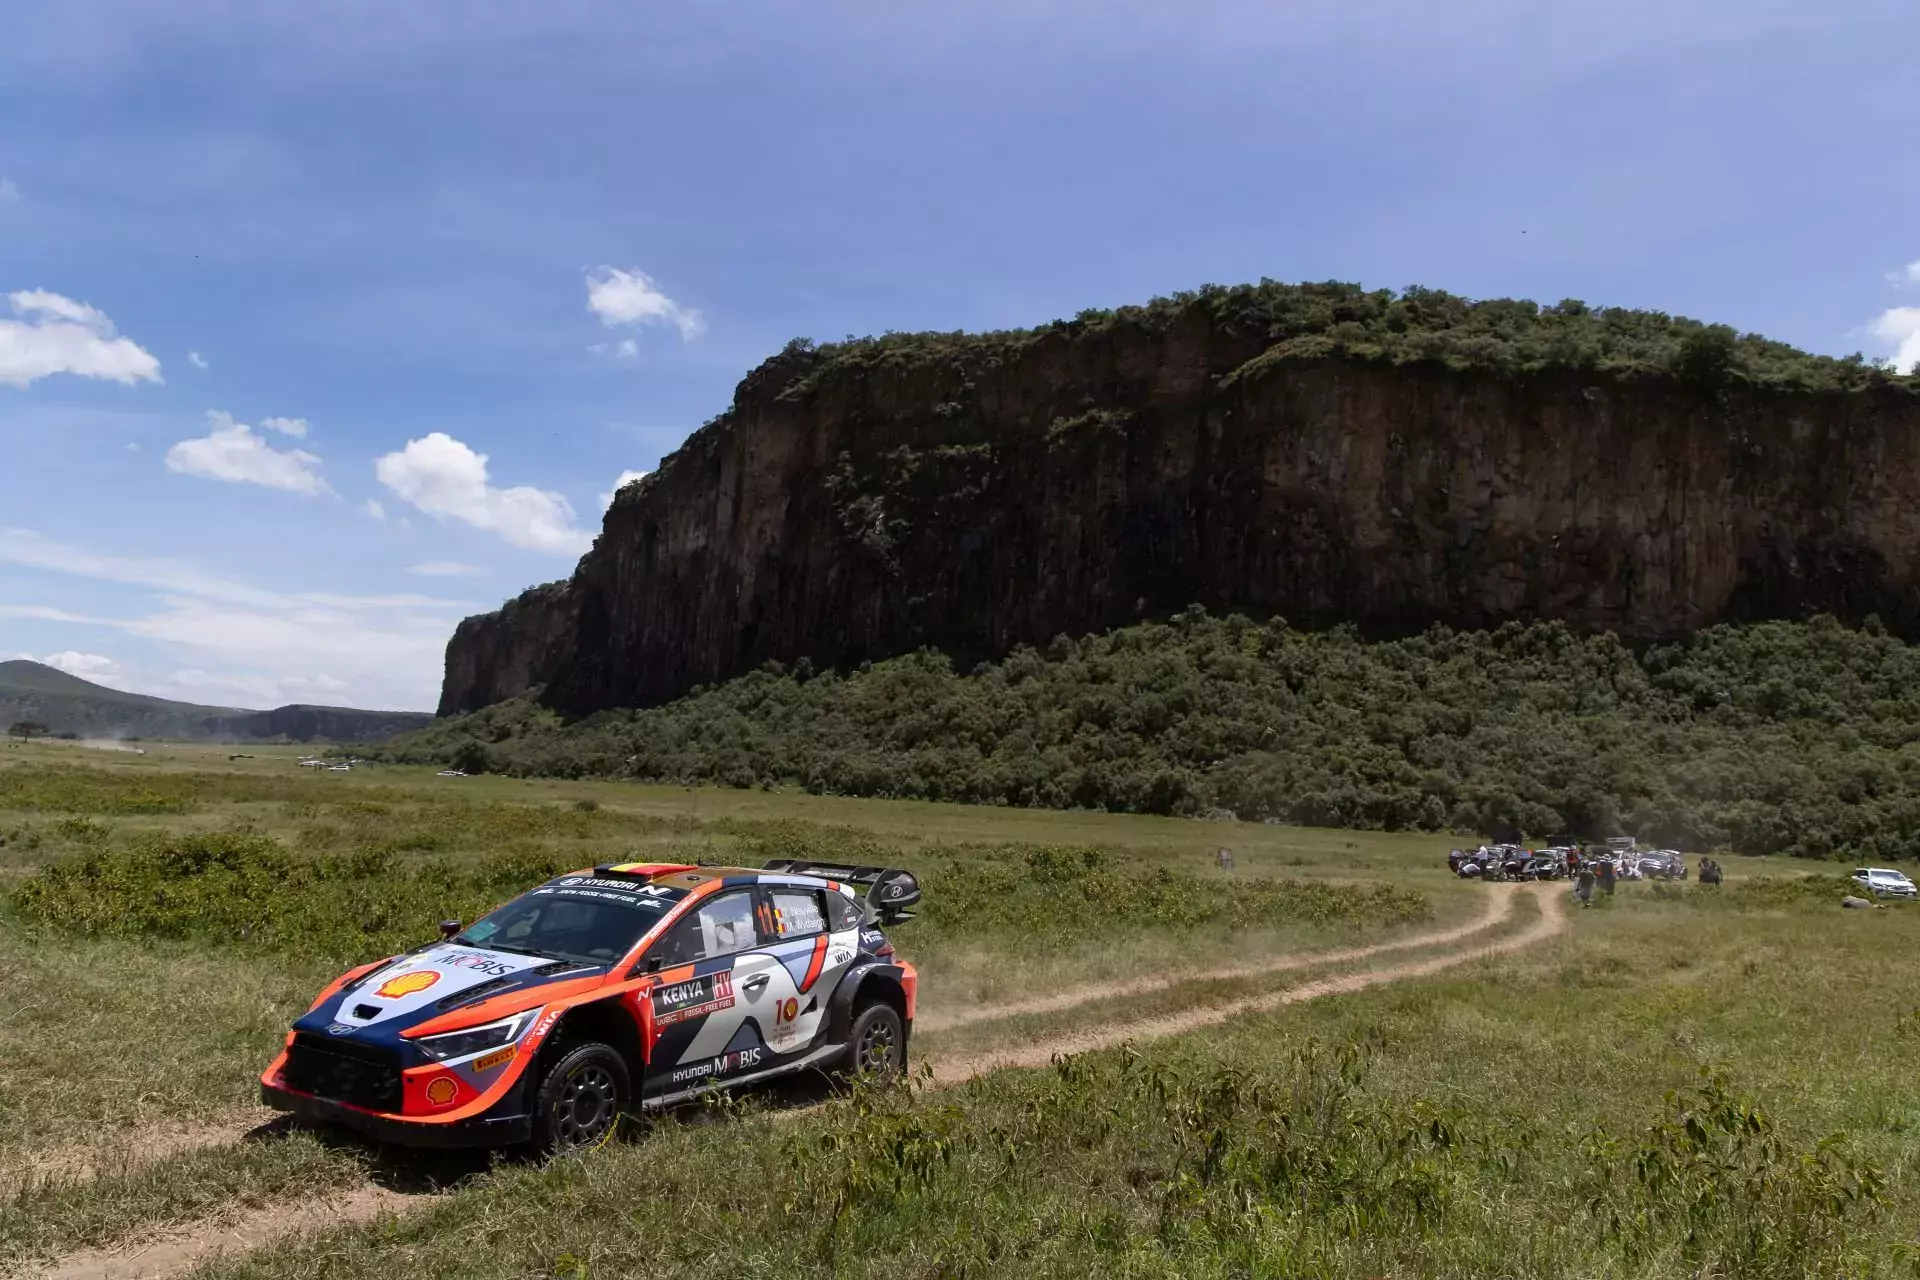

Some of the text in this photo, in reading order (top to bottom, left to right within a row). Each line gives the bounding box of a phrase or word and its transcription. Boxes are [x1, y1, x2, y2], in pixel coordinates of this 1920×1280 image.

[581, 879, 672, 896] HYUNDAI N
[756, 902, 774, 935] 11
[433, 955, 516, 976] MOBIS
[835, 951, 853, 964] WIA
[662, 981, 704, 1005] KENYA
[714, 972, 731, 998] HY
[684, 1003, 719, 1019] FOSSIL-FREE
[719, 1000, 733, 1009] FUEL
[536, 1010, 562, 1036] WIA
[477, 1047, 515, 1070] PIRELLI
[673, 1047, 761, 1082] HYUNDAI MOBIS
